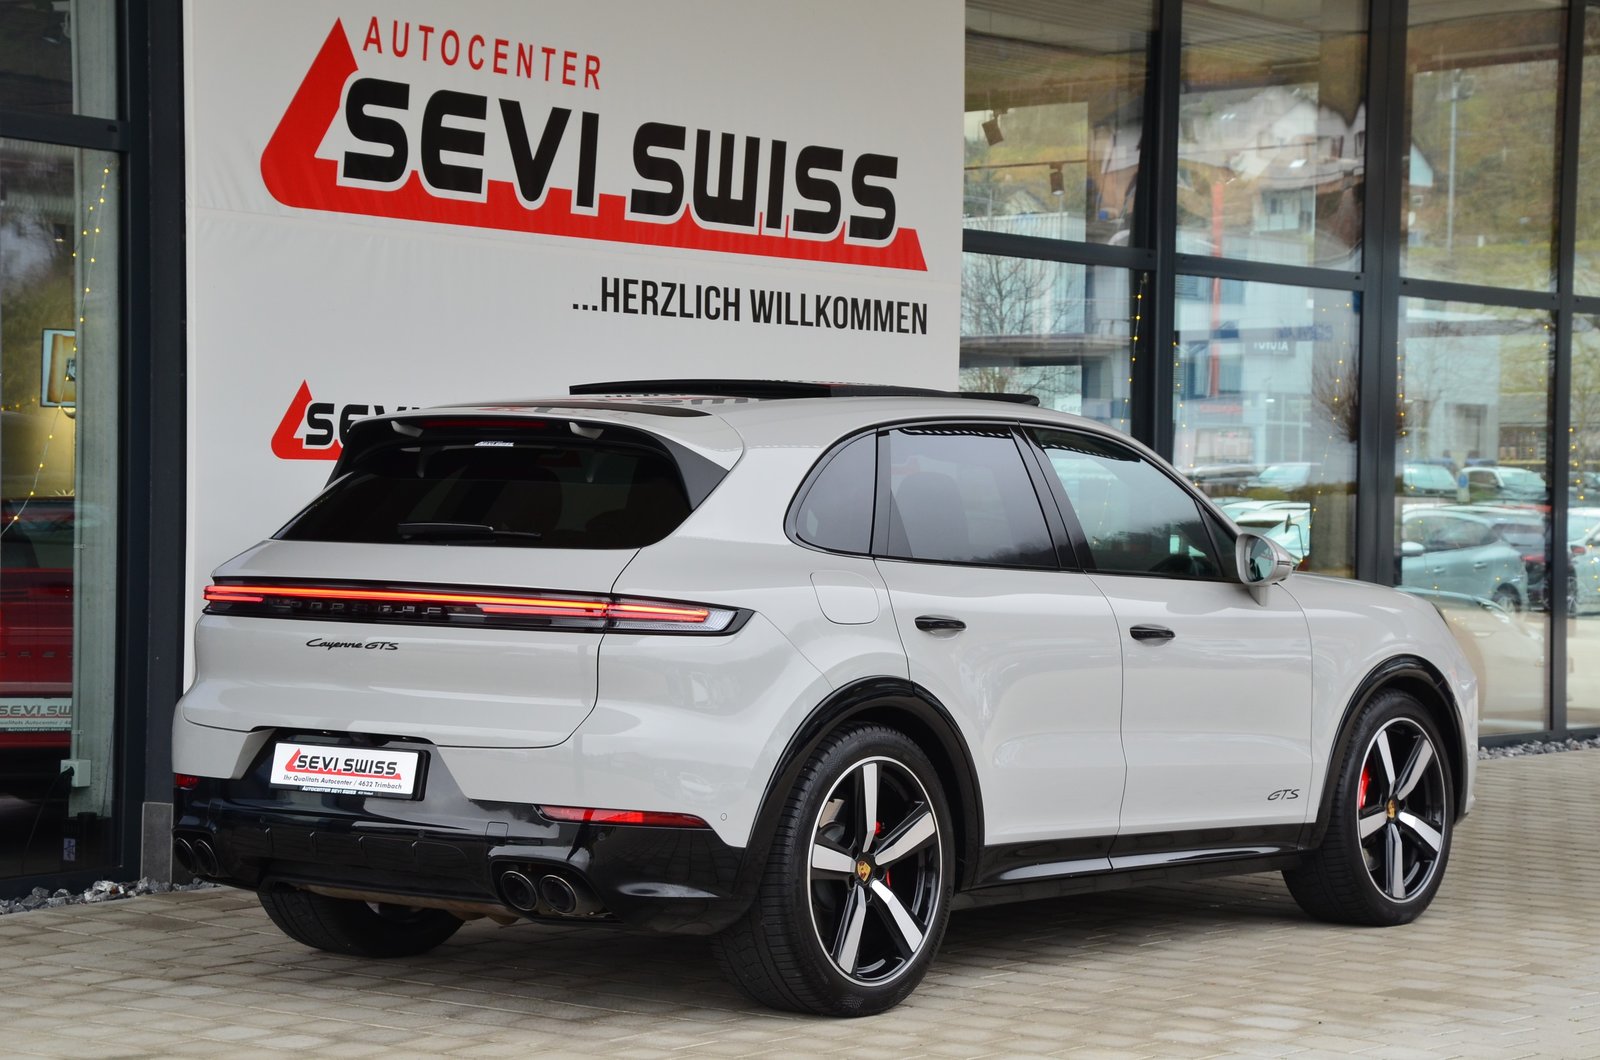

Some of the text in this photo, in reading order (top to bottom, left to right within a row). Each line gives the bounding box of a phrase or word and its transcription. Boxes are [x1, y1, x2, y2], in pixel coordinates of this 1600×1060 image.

[363, 16, 601, 90] AUTOCENTER
[342, 77, 898, 241] SEVI SWISS
[572, 277, 928, 335] ...HERZLICH WILLKOMMEN
[305, 402, 421, 446] SE
[306, 637, 399, 651] Cayenne GTS
[297, 755, 398, 775] SEVI SWISS
[320, 777, 352, 785] Autocenter
[358, 780, 374, 788] 4632
[374, 781, 402, 790] Trimbach
[1267, 788, 1301, 801] GTS
